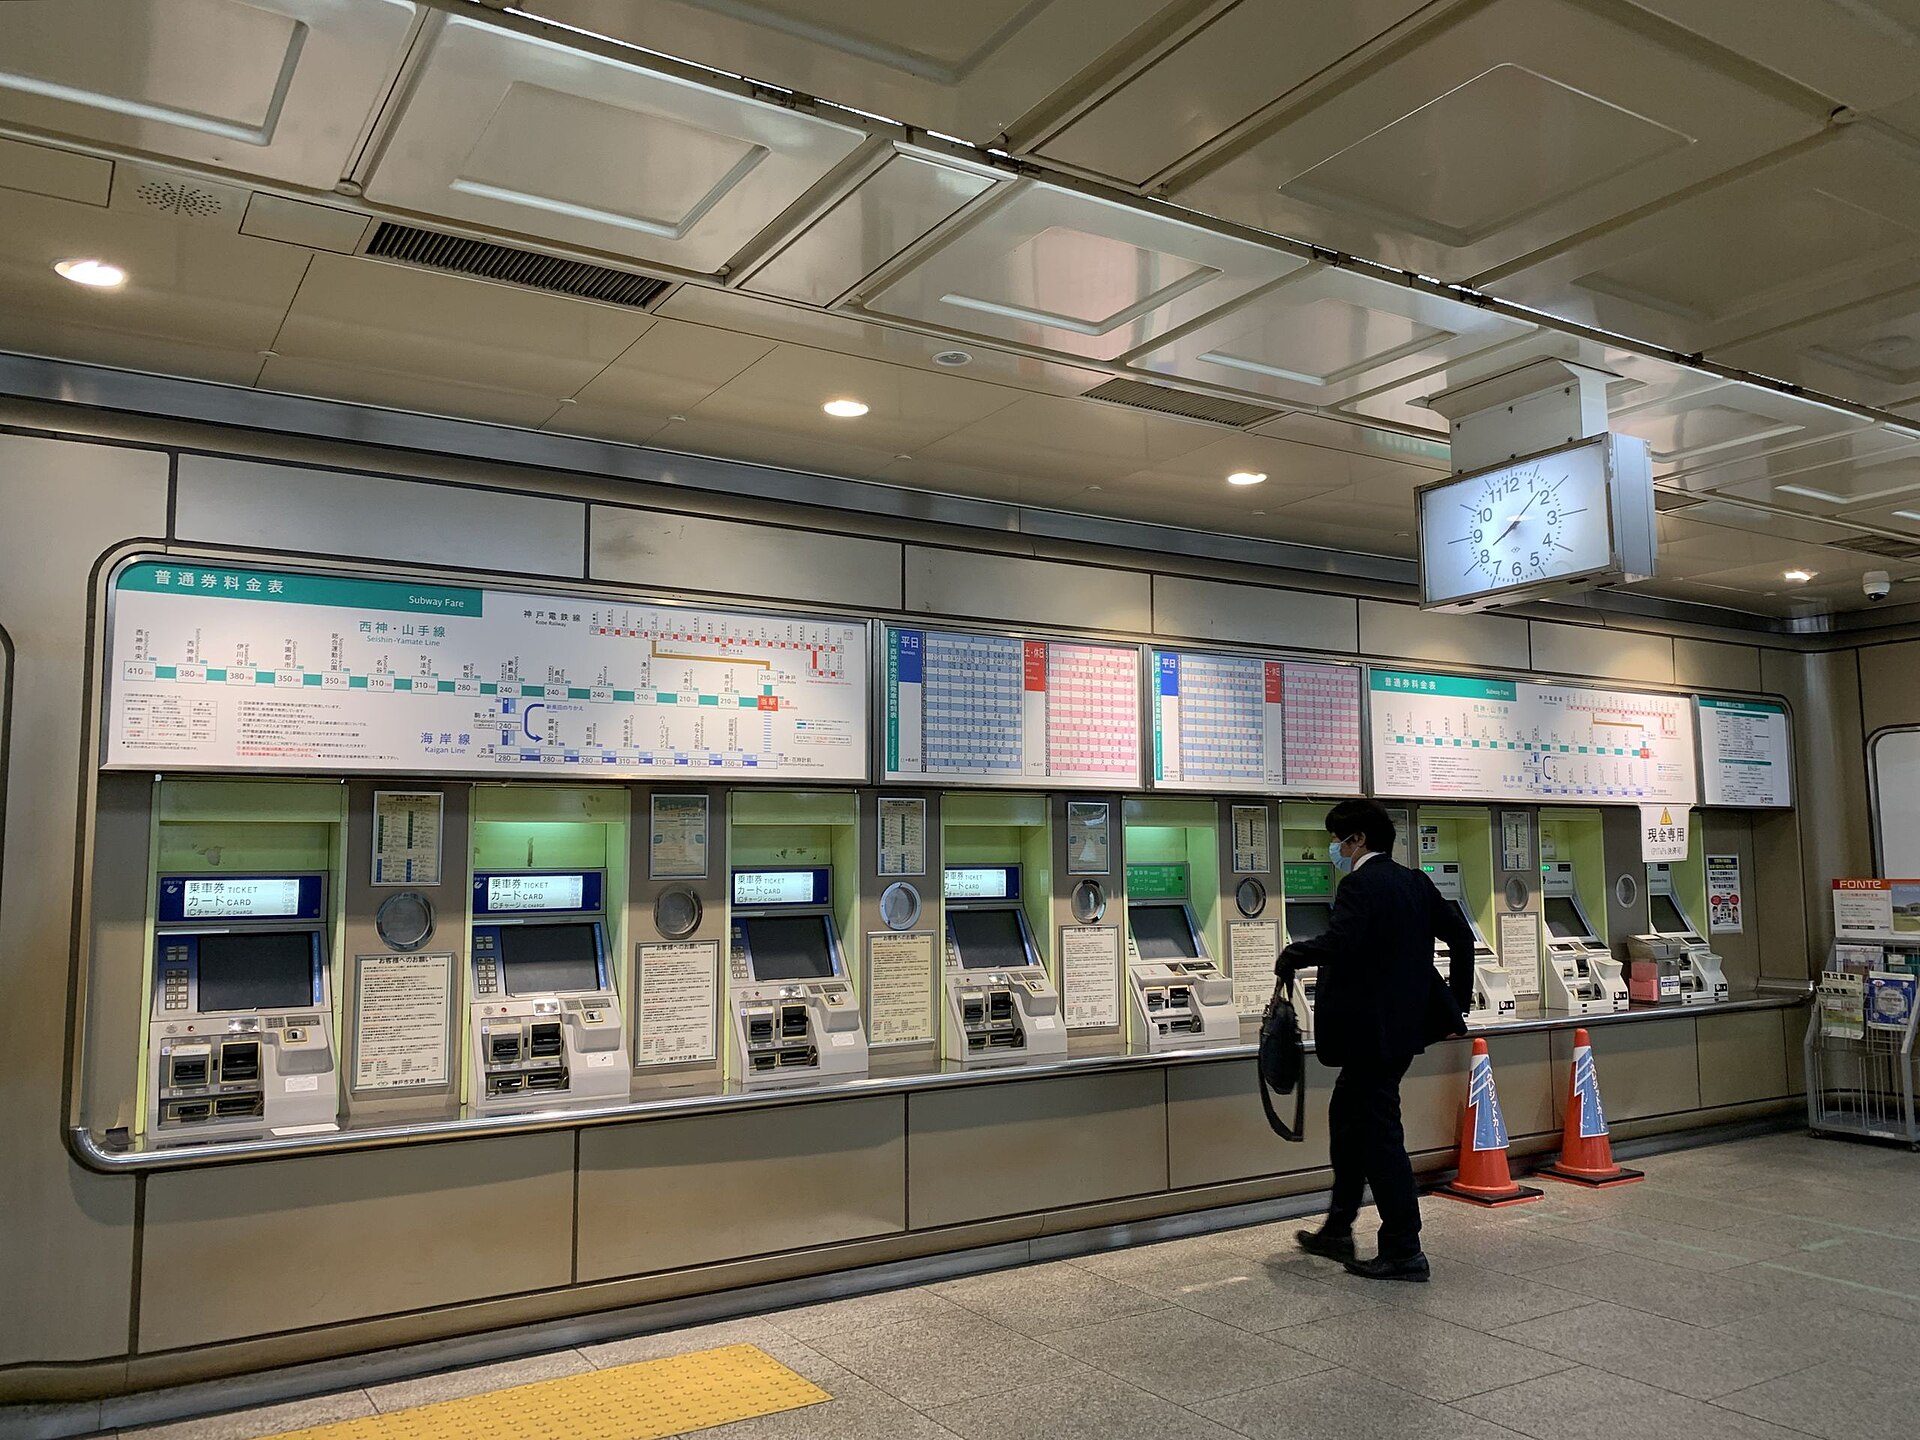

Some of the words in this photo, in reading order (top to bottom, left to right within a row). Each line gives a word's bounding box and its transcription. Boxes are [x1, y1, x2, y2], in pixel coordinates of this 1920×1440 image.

[1502, 476, 1520, 493] 12
[1527, 478, 1534, 493] 1
[1488, 487, 1502, 504] 11
[1539, 489, 1551, 505] 2
[1476, 507, 1493, 523] 10
[1546, 509, 1558, 525] 3
[1472, 528, 1483, 544] 9
[1542, 532, 1553, 547] 4
[1480, 549, 1490, 564] 8
[1529, 551, 1540, 567] 5
[1492, 559, 1503, 575] 7
[1511, 561, 1522, 577] 6
[154, 569, 284, 594] 普通券料金表
[409, 595, 443, 607] Subway
[444, 598, 465, 608] Fare
[359, 620, 446, 638] 西神・山手線
[135, 629, 143, 660] 西神中央
[366, 635, 423, 646] Seishin-Yamate
[425, 639, 441, 647] Line
[900, 635, 919, 649] 平日
[1024, 647, 1045, 659] 土・休日
[1162, 658, 1176, 669] 平日
[127, 667, 144, 675] 410
[179, 669, 195, 678] 380
[229, 672, 245, 681] 380
[277, 675, 293, 683] 350
[324, 677, 339, 685] 350
[760, 673, 771, 681] 210
[370, 679, 384, 687] 310
[414, 681, 428, 689] 310
[457, 684, 471, 692] 280
[1384, 676, 1437, 690] 普通券料金表
[499, 686, 513, 694] 240
[546, 688, 560, 696] 240
[592, 691, 605, 699] 240
[636, 693, 649, 701] 210
[679, 695, 691, 703] 210
[720, 697, 732, 705] 210
[498, 722, 512, 730] 240
[420, 731, 471, 745] 海岸線
[424, 747, 449, 755] Kaigan
[450, 747, 466, 755] Line
[1647, 827, 1685, 843] 現金専用
[491, 878, 521, 889] 乗車券
[738, 874, 762, 884] 乗車券
[188, 882, 225, 894] 乗車券
[228, 886, 258, 894] TICKET
[737, 886, 762, 895] カード
[188, 895, 225, 907] カード
[226, 898, 252, 906] CARD
[491, 891, 521, 901] カード
[186, 908, 225, 916] ICチャージ
[656, 943, 701, 951] お客様へのお願い
[378, 956, 432, 965] お客様へのお願い
[392, 1077, 426, 1086] 神戸市交通局
